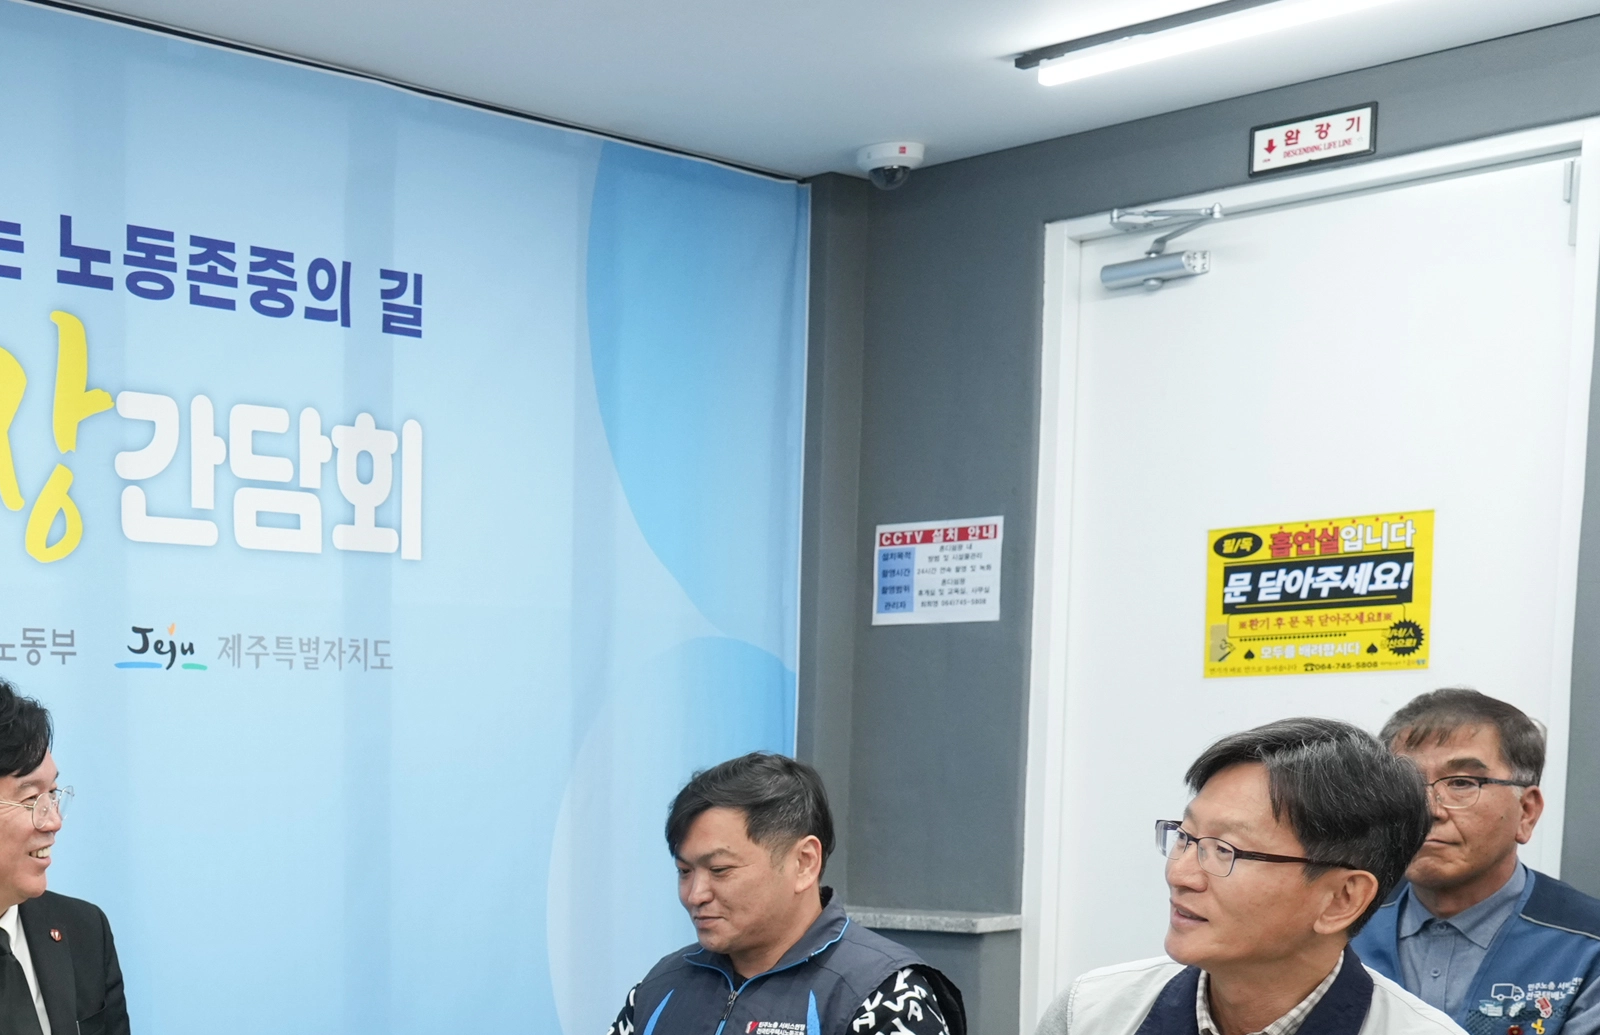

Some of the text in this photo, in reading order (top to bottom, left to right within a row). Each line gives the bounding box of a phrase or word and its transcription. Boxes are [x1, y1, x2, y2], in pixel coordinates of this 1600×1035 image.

[1283, 138, 1352, 158] DESCENDING LIFE LINE
[57, 215, 352, 328] 노동존중의
[380, 268, 424, 338] 길
[114, 390, 424, 562] 간담회
[882, 524, 995, 546] CCTV 설치 안내
[1270, 520, 1416, 558] 흡연실입니다
[1224, 562, 1414, 604] 문 닫아주세요!
[126, 625, 196, 670] Jeju
[216, 632, 394, 674] 제주특별자치도
[1260, 641, 1360, 659] 모두를 배려합시다
